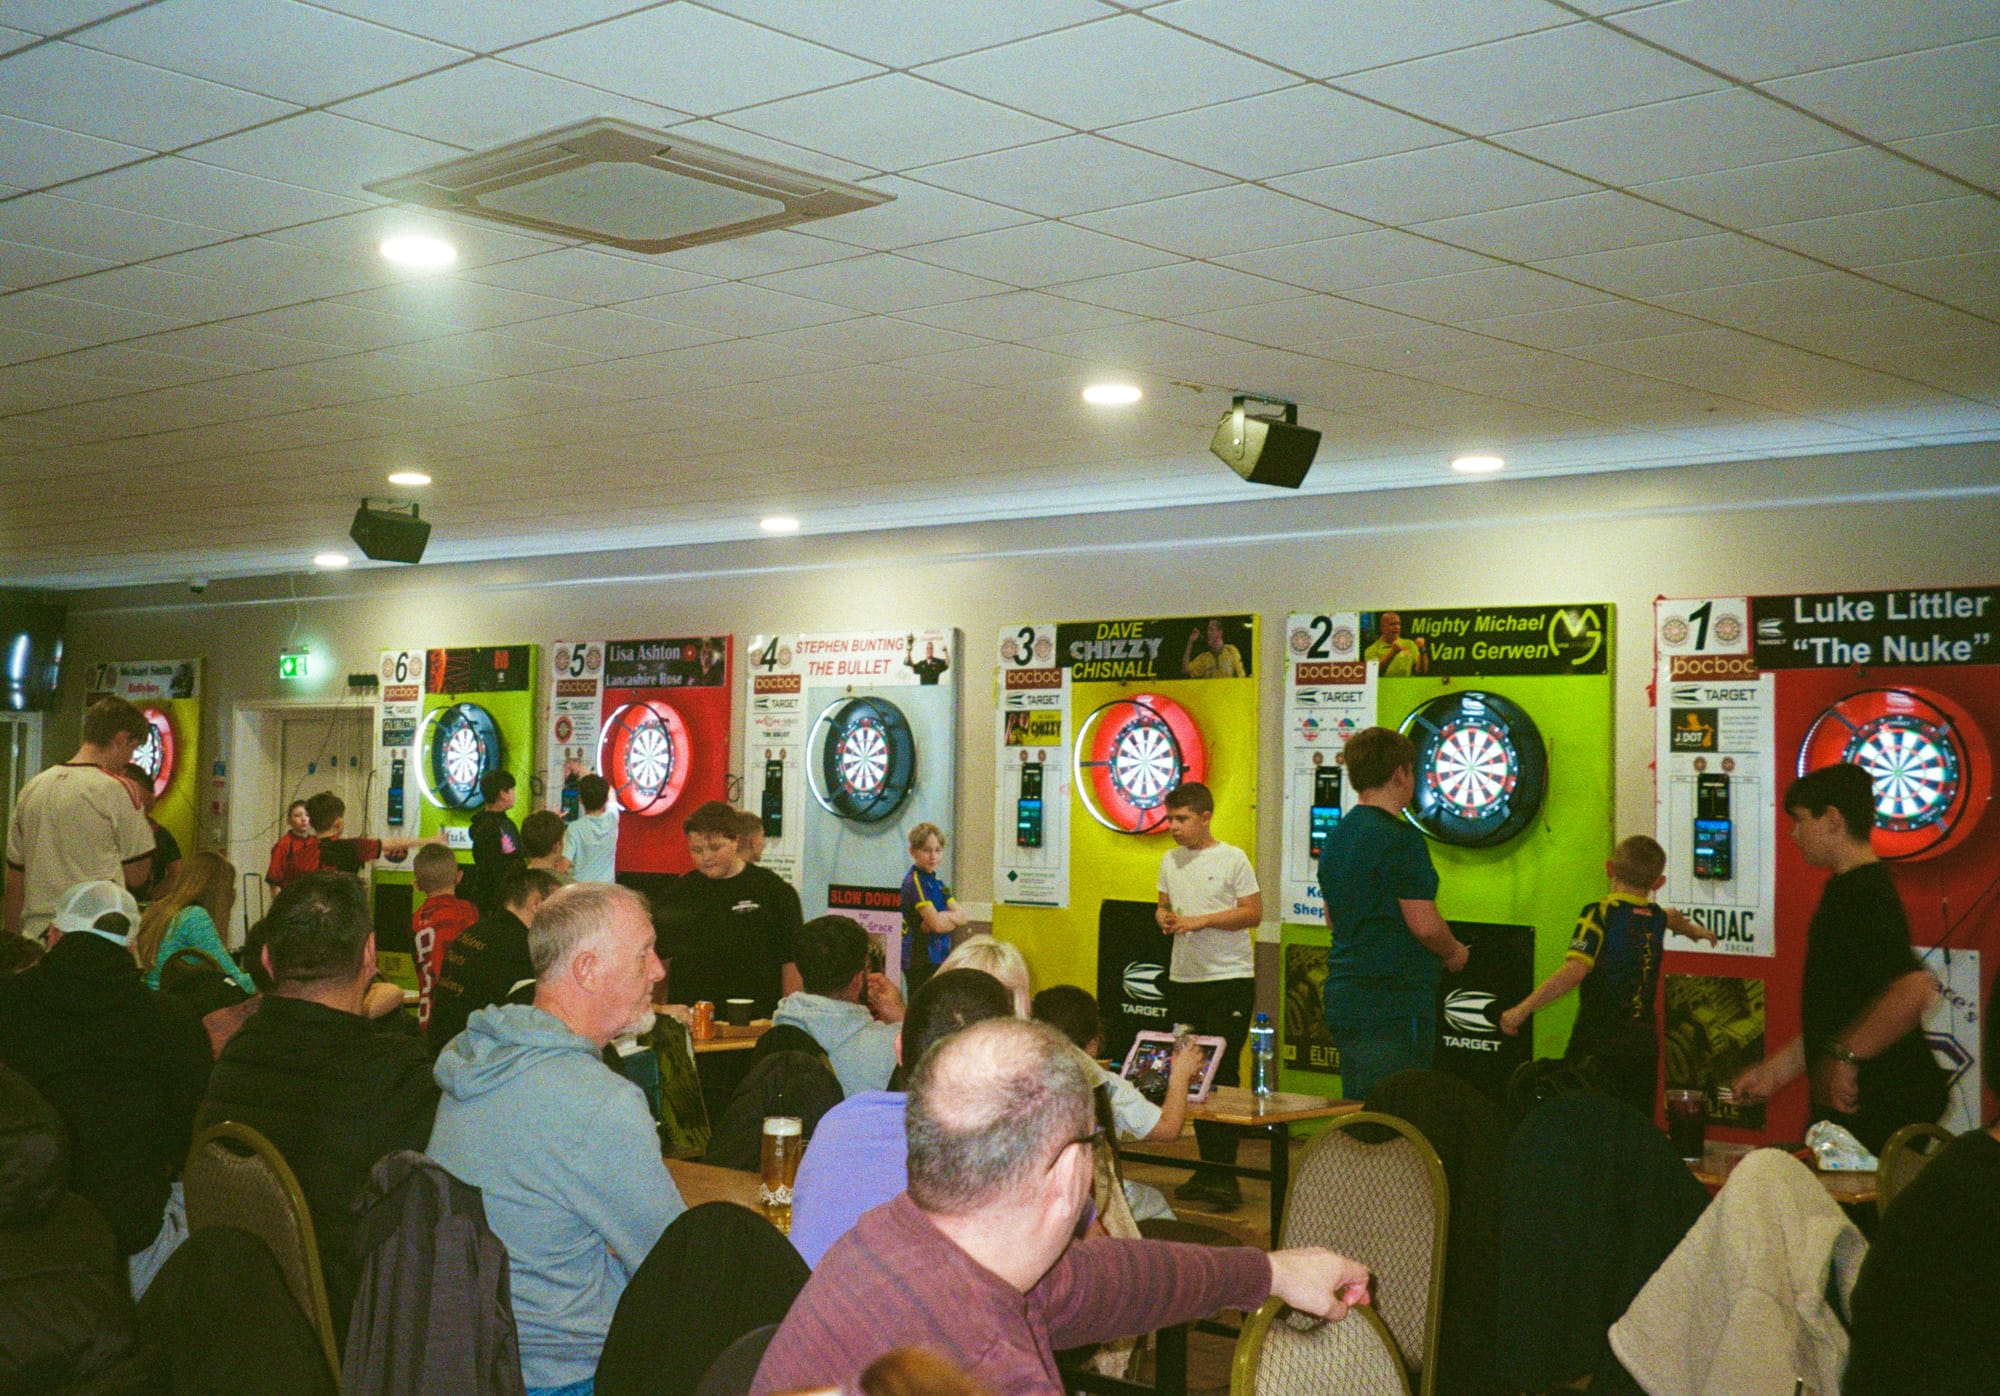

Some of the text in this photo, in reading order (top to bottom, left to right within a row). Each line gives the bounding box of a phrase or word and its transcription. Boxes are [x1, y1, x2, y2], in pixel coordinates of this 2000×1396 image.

[1795, 591, 1990, 623] Luke Littler
[1096, 622, 1144, 640] DAVE
[1411, 614, 1545, 637] Mighty Michael
[1688, 600, 1713, 651] 1
[795, 637, 905, 655] STEPHEN BUNTING
[1013, 626, 1035, 666] 3
[1306, 615, 1333, 659] 2
[610, 644, 680, 661] Lisa Ashton
[760, 636, 779, 672] 4
[1069, 638, 1164, 661] CHIZZY
[1429, 642, 1549, 661] Van Gerwen
[1792, 633, 1991, 665] “The Nuke”
[395, 651, 409, 683] 6
[569, 643, 586, 677] 5
[808, 659, 892, 676] THE BULLET
[1072, 660, 1158, 680] CHISNALL
[606, 673, 683, 687] Lancashire Rose
[771, 699, 799, 708] TARGET
[1026, 694, 1060, 705] TARGET
[1320, 691, 1364, 702] TARGET
[1703, 688, 1757, 701] TARGET
[1030, 721, 1062, 738] CHIZZY
[830, 890, 901, 907] SLOW DOWN
[1121, 1003, 1168, 1017] TARGET
[1443, 1035, 1503, 1052] TARGET
